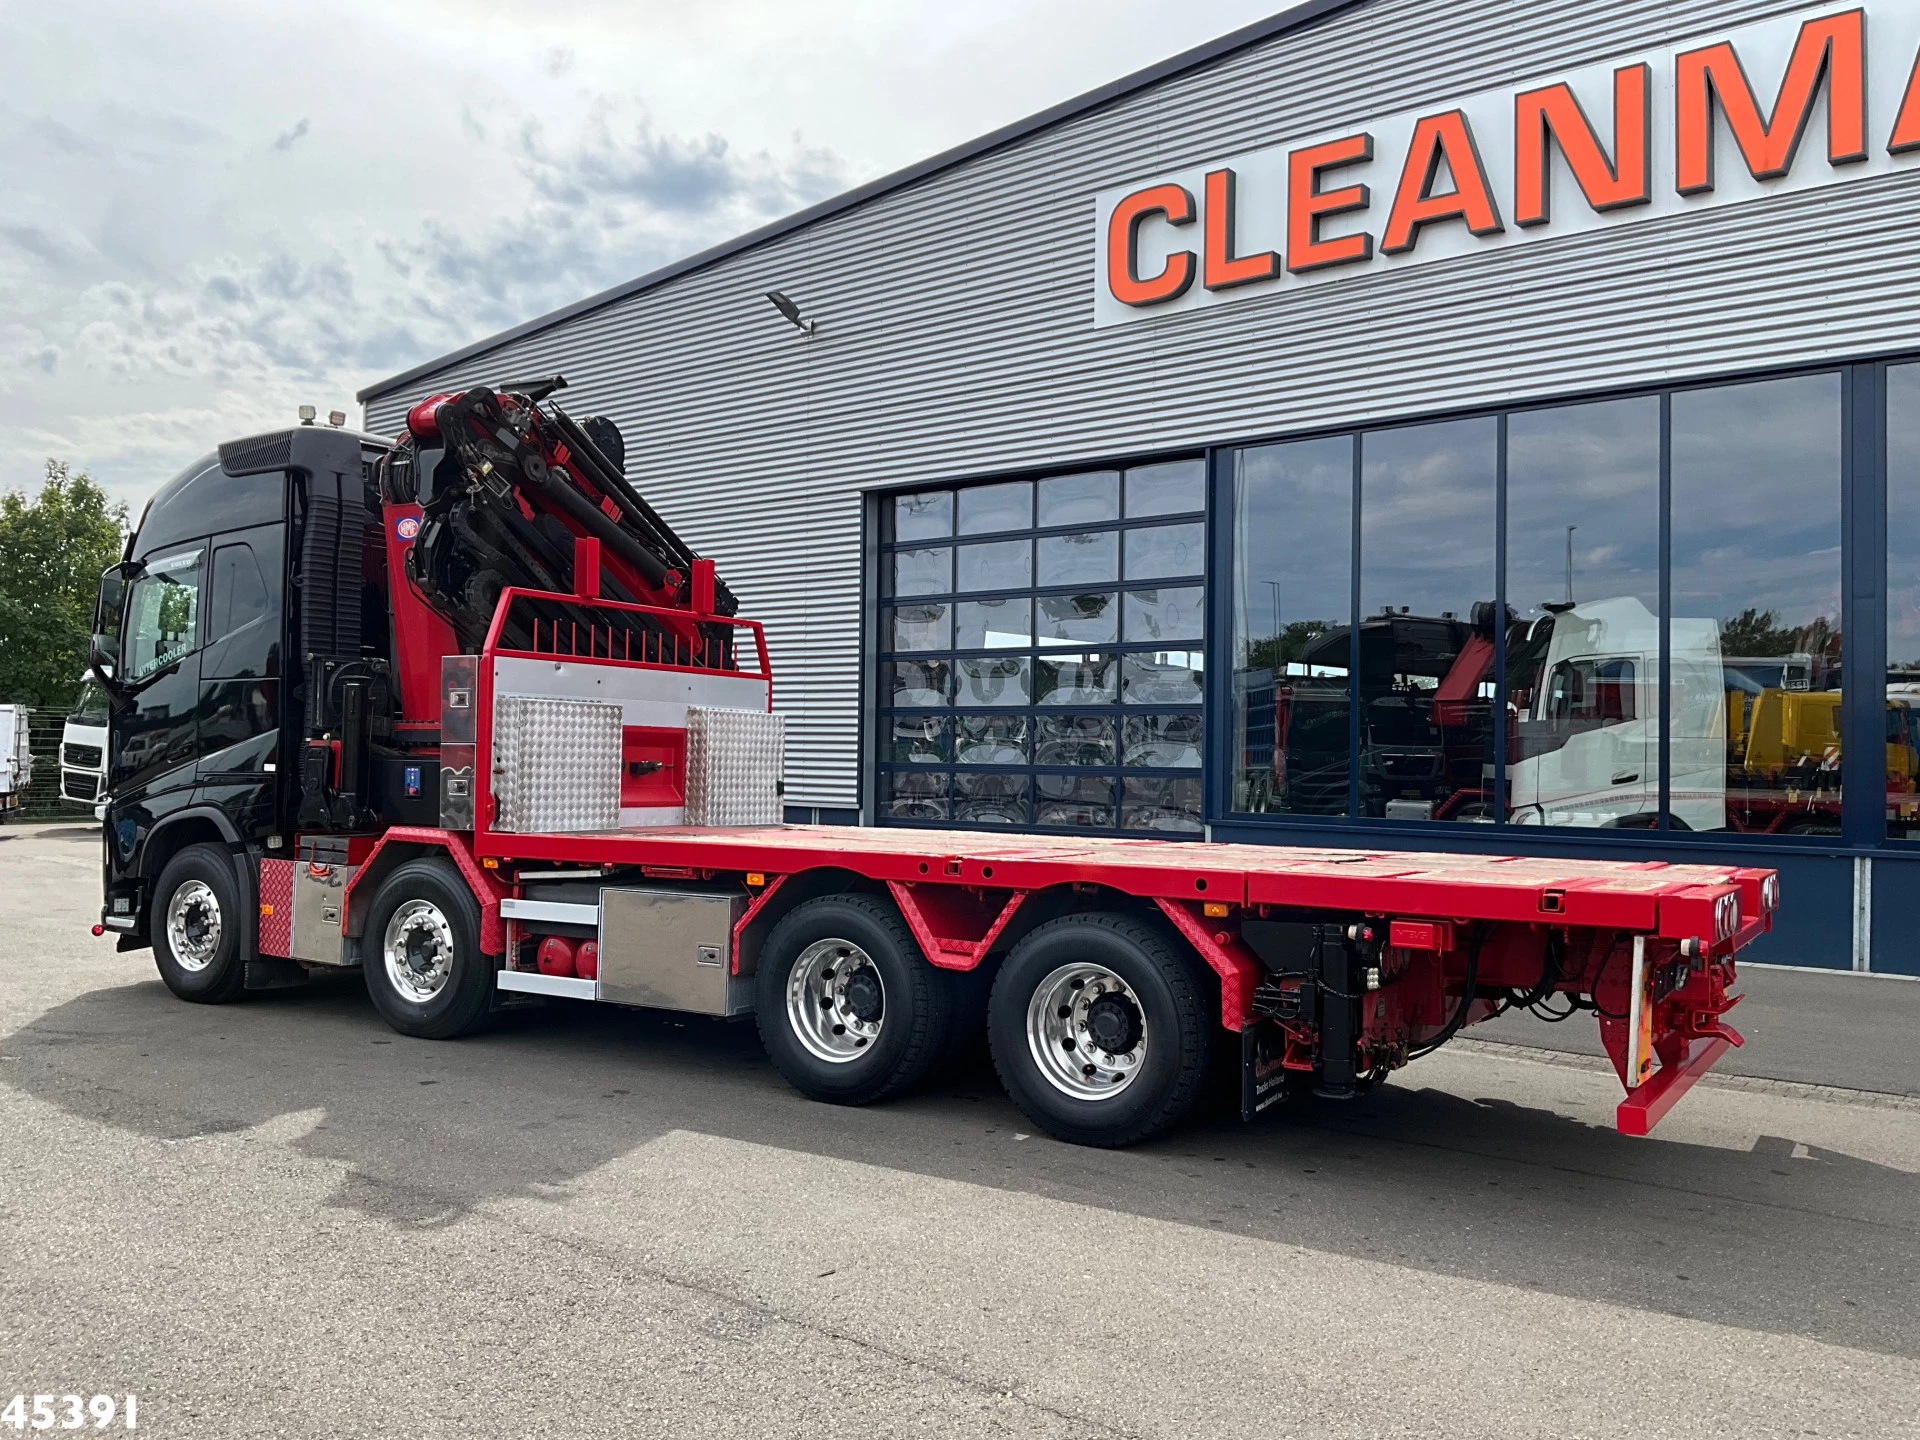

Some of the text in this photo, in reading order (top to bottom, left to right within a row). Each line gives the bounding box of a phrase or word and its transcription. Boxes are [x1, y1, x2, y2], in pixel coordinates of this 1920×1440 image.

[1106, 6, 1920, 308] CLEANM
[400, 521, 416, 536] HMF
[139, 642, 187, 676] INTERCOOLER
